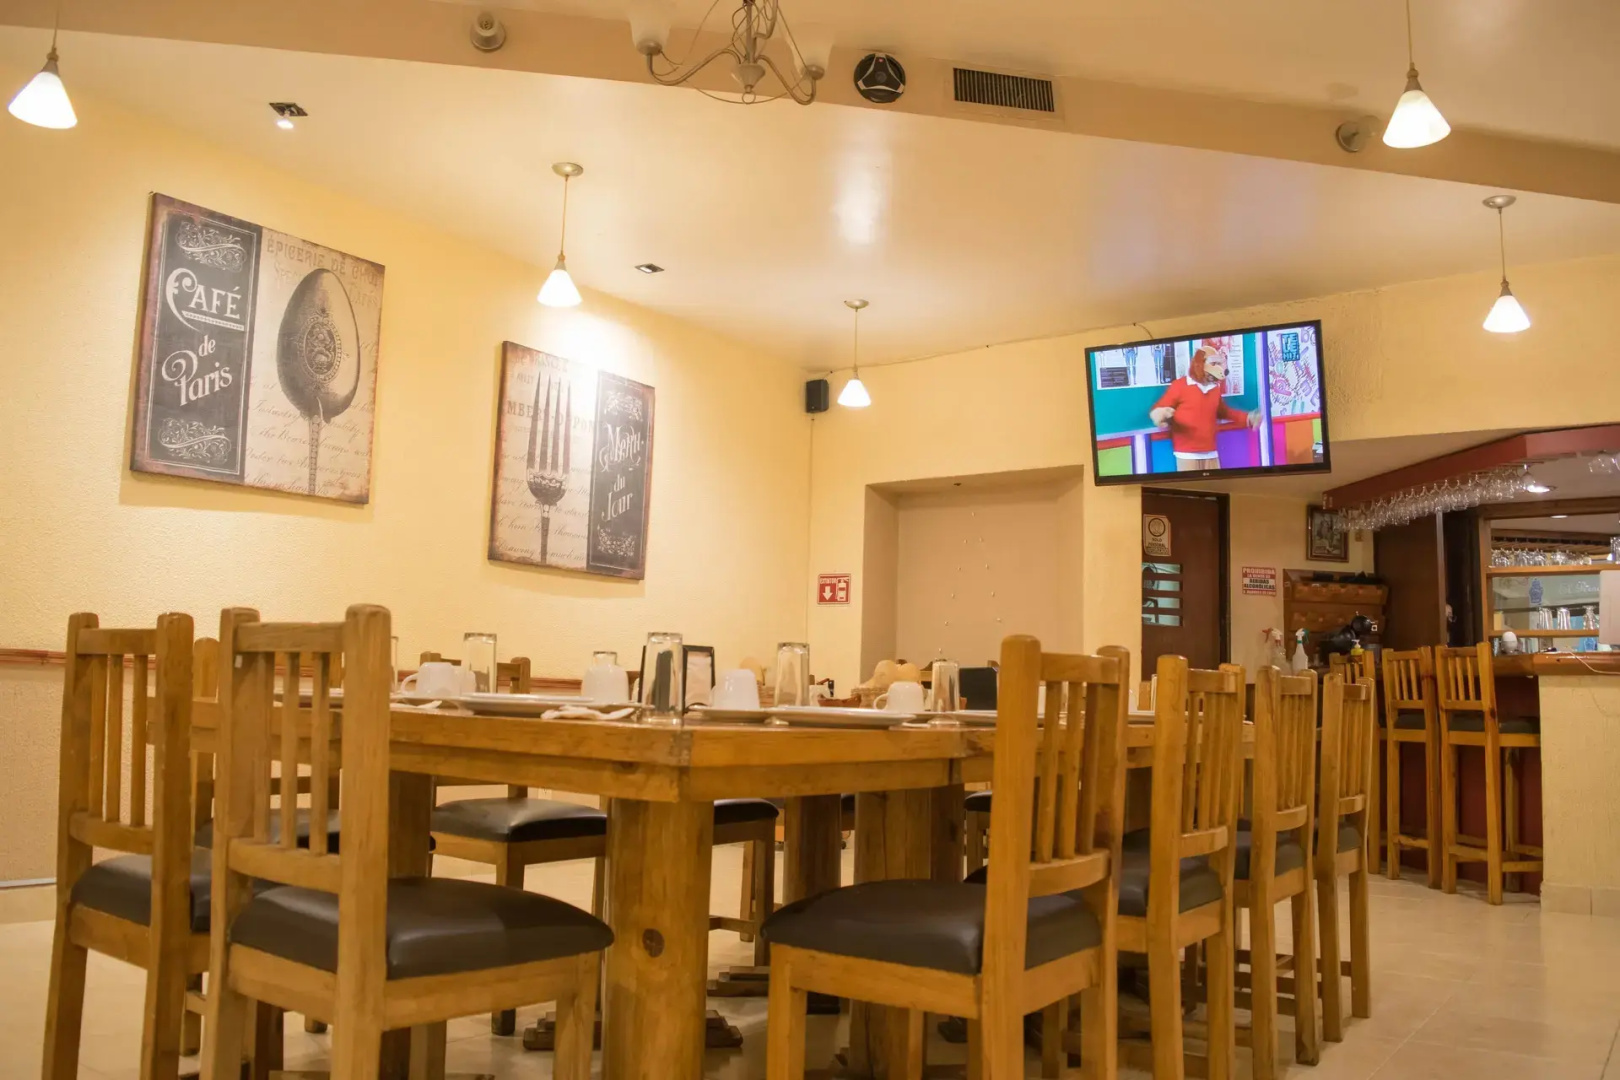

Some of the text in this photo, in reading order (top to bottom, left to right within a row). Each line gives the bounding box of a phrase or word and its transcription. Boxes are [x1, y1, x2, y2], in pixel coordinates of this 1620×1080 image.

[166, 268, 242, 332] CAFÉ
[198, 334, 216, 357] de
[162, 350, 233, 407] Paris
[613, 473, 626, 492] du
[601, 491, 633, 521] Jour
